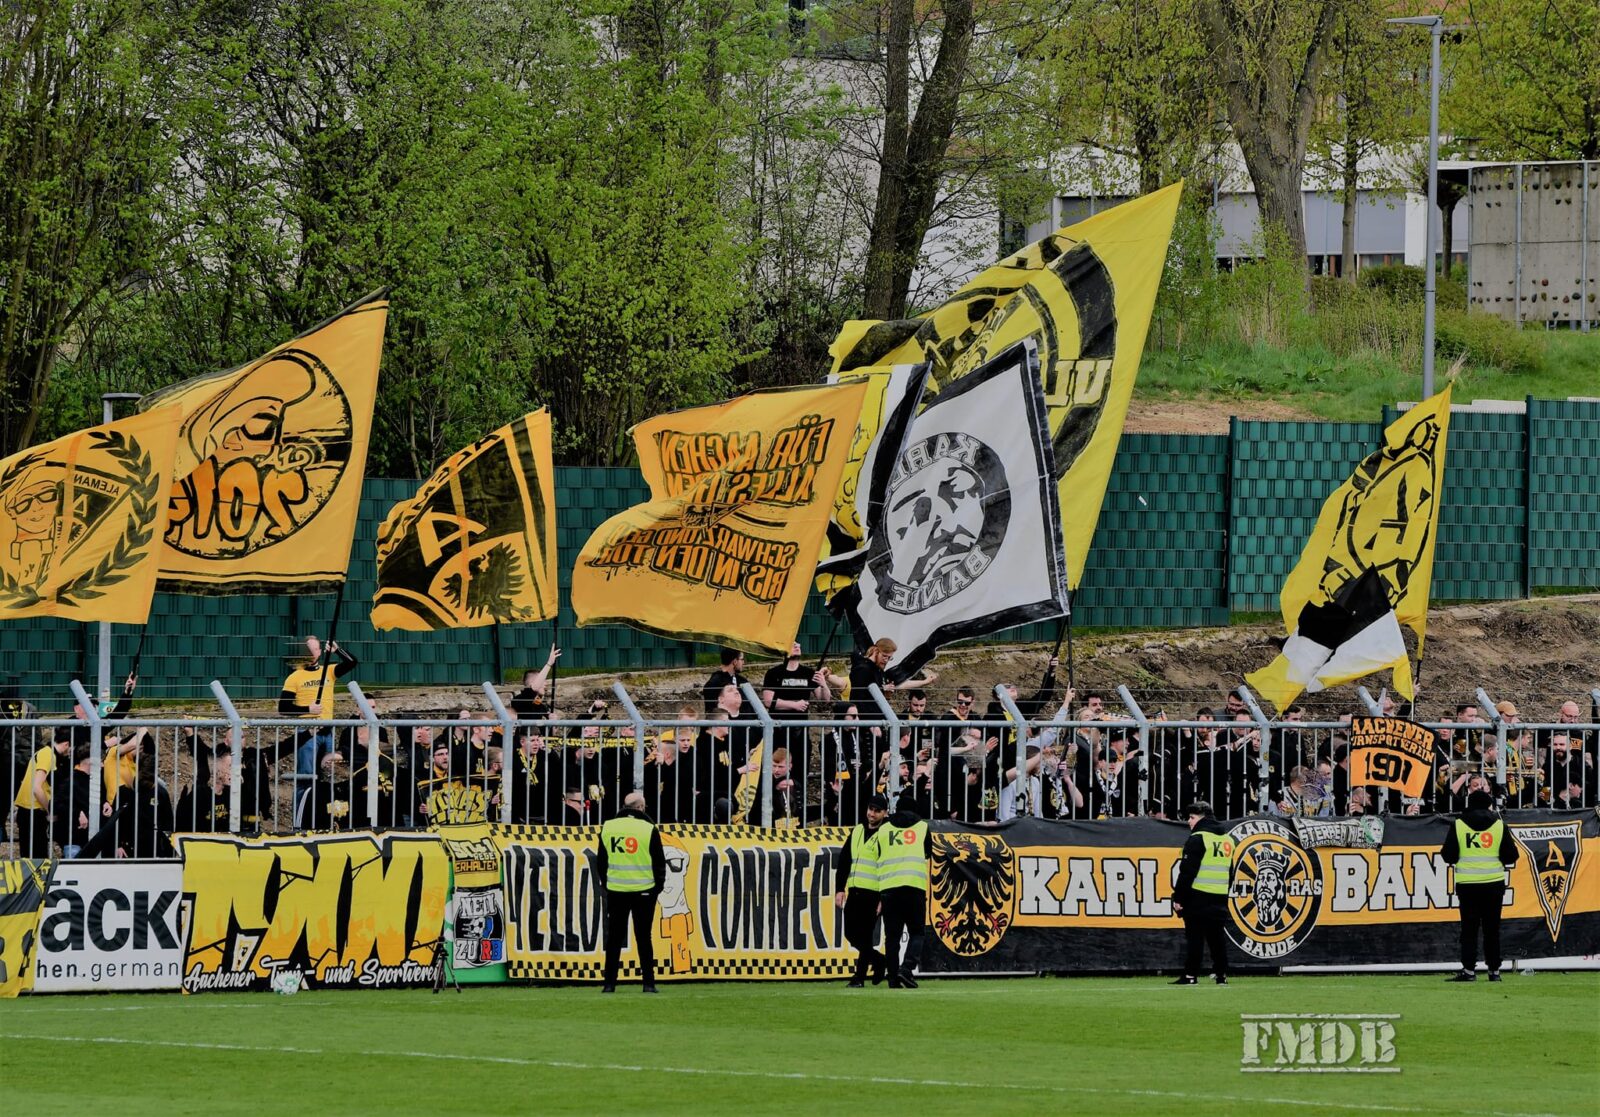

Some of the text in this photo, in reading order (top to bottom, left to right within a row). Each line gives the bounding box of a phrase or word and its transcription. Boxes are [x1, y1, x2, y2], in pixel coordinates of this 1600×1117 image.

[1352, 717, 1435, 751] AACHENER
[1365, 751, 1413, 786] 1901
[889, 829, 917, 846] K9
[1232, 821, 1290, 841] KARLS
[1466, 832, 1493, 848] K9
[1518, 827, 1575, 839] ALEMANNIA
[610, 836, 638, 854] K9
[1213, 841, 1232, 858] K9
[455, 860, 498, 873] ERHALTEN
[1229, 879, 1322, 898] LT RAS
[1332, 852, 1513, 913] BAN
[700, 846, 882, 950] CONNECT
[456, 939, 503, 961] ZU RB
[1242, 935, 1297, 957] BANDE
[183, 964, 256, 992] Aachener
[324, 961, 356, 984] und
[359, 958, 440, 988] Sportverei
